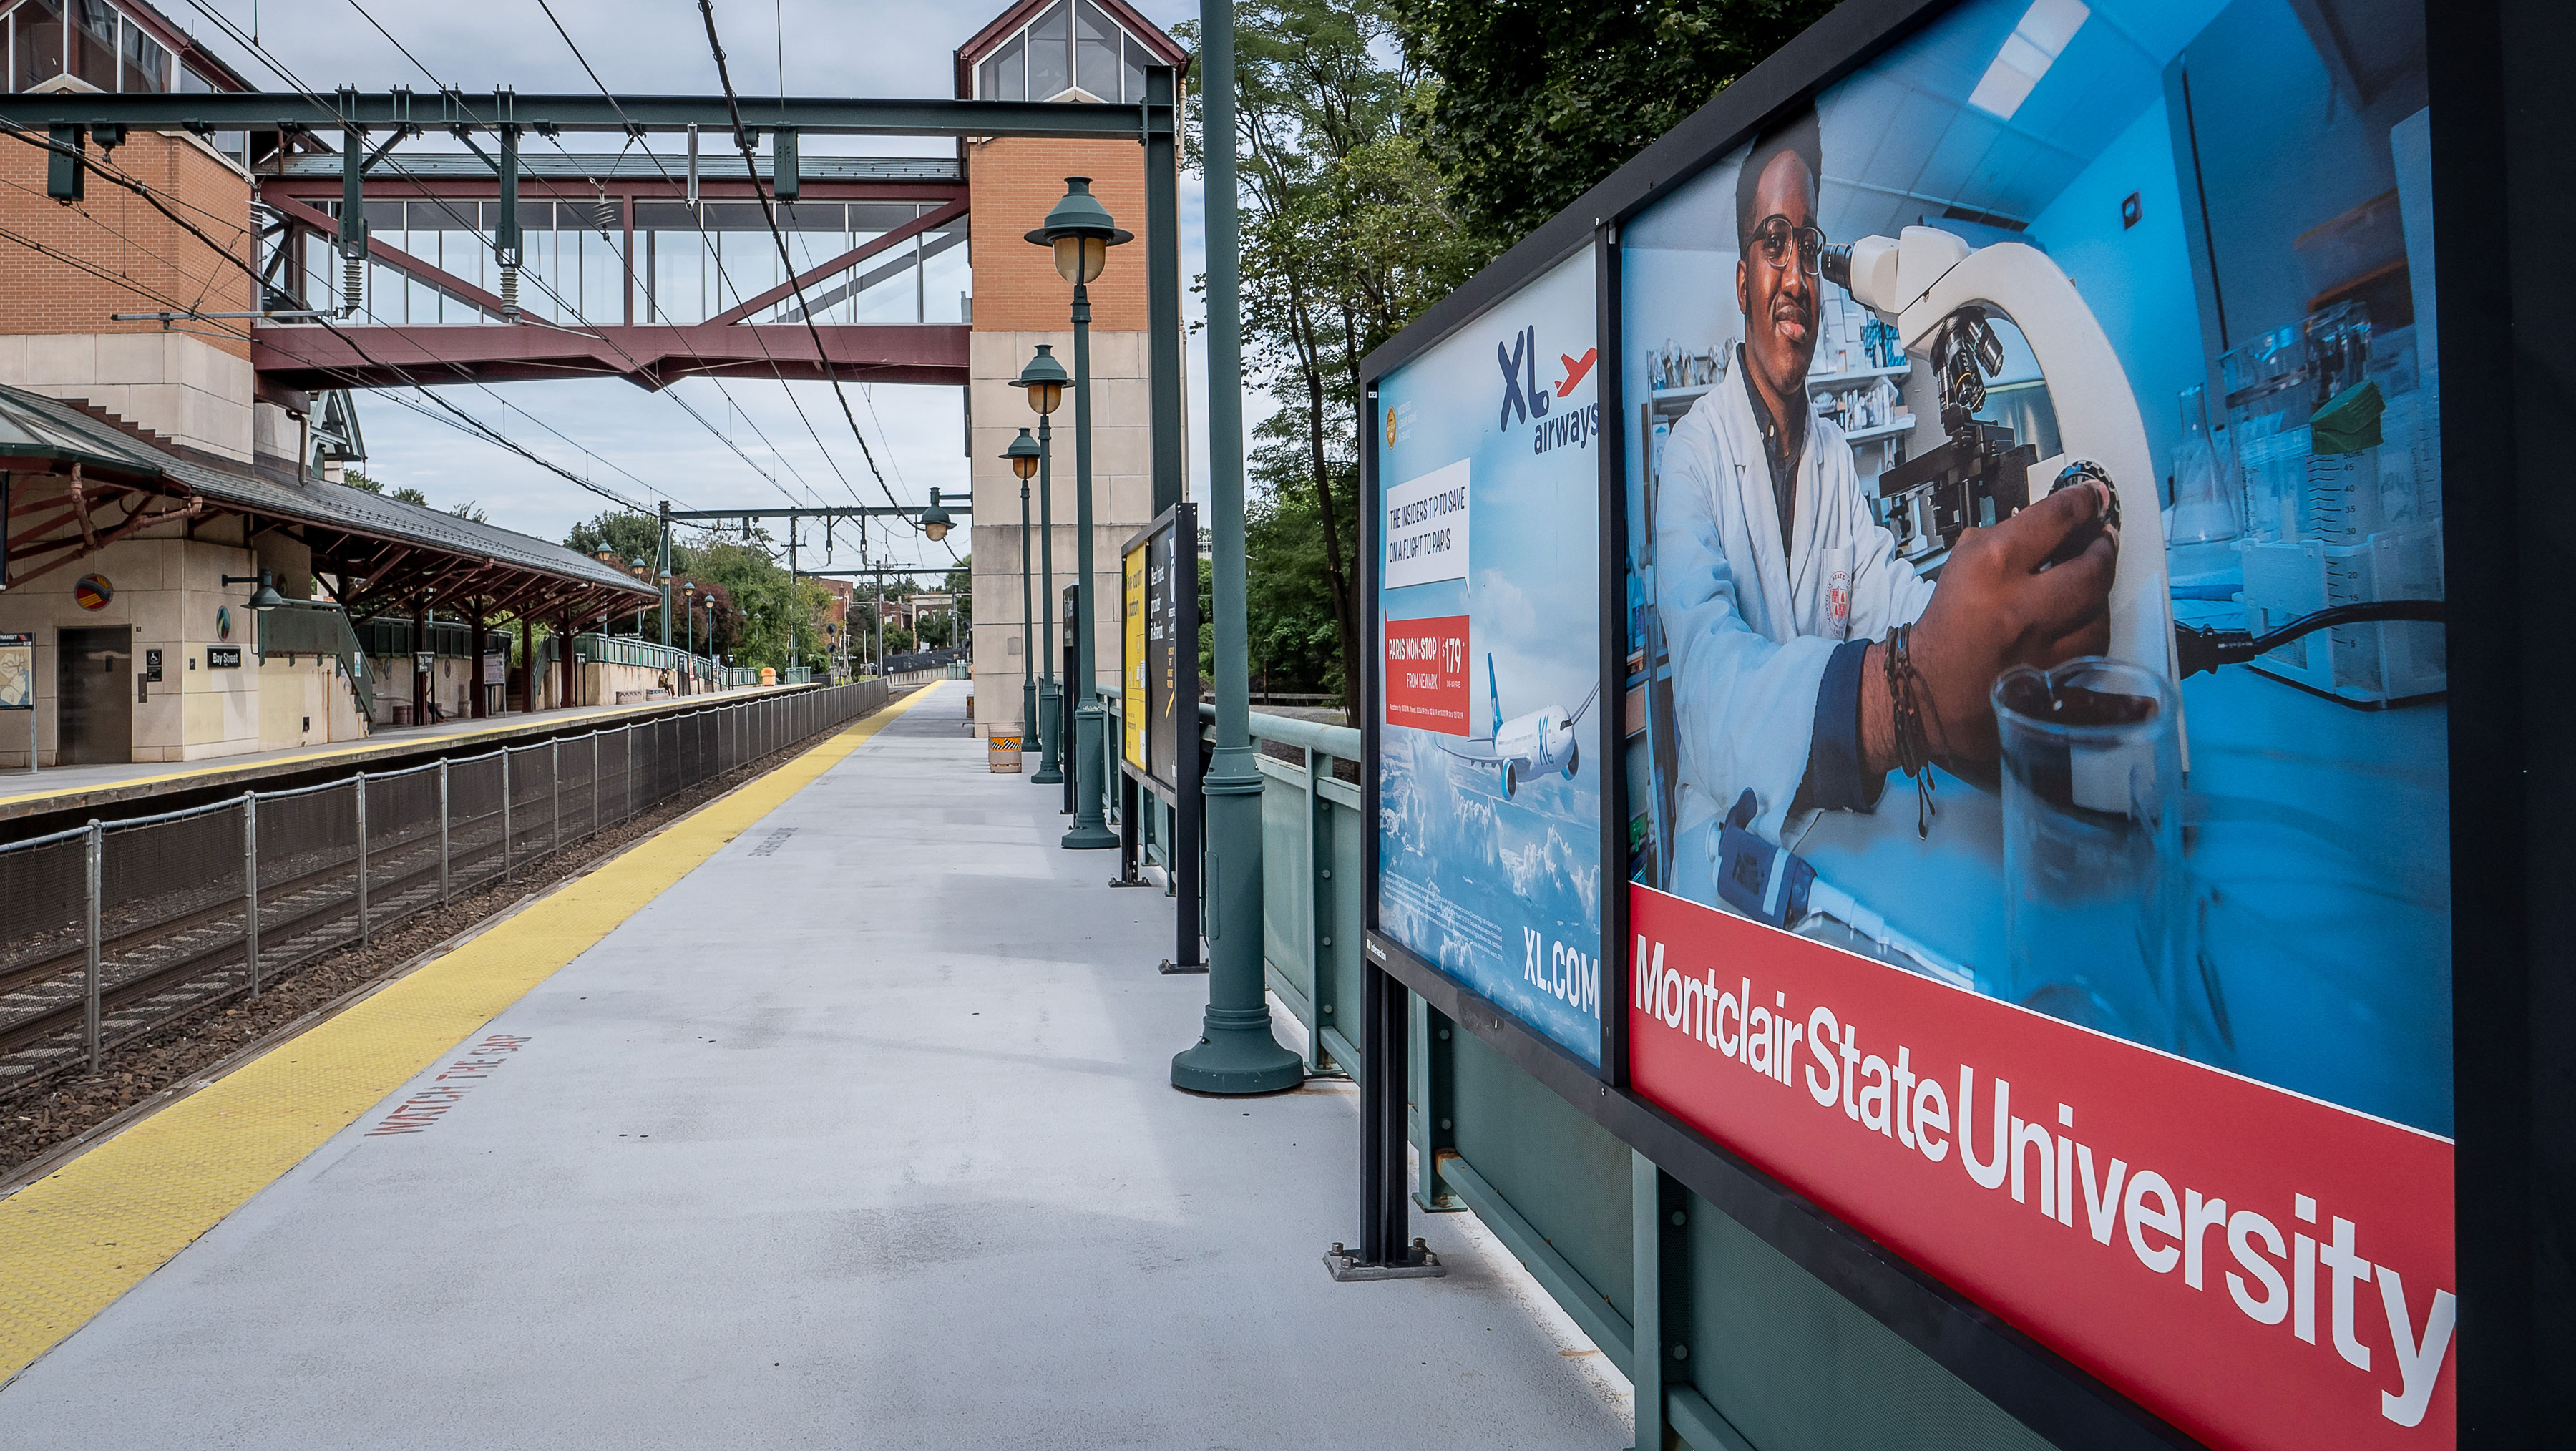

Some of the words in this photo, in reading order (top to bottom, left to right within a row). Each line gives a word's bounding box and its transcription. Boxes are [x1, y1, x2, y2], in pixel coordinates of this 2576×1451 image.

[1498, 324, 1549, 433] XL
[1534, 403, 1598, 455] airways
[1390, 508, 1400, 530] THE
[1401, 499, 1428, 527] INSIDERS
[1428, 495, 1438, 519] TIP
[1439, 492, 1448, 516] TO
[1448, 486, 1465, 513] SAVE
[2346, 505, 2356, 514] 35
[1390, 541, 1397, 563] ON
[1397, 540, 1402, 561] A
[1403, 535, 1423, 560] FLIGHT
[1423, 532, 1431, 555] TO
[1433, 527, 1450, 554] PARIS
[213, 653, 223, 665] Bay
[223, 653, 238, 663] Street
[1389, 638, 1405, 660] PARIS
[1406, 637, 1437, 660] NON-STOP
[1407, 673, 1418, 688] FROM
[1419, 673, 1438, 690] NEWARK
[1523, 925, 1600, 1020] XL.COM
[467, 1035, 533, 1055] GAP
[435, 1058, 507, 1082] THE
[364, 1085, 476, 1137] WATCH
[1636, 934, 1803, 1088] Montclair
[1805, 1006, 1951, 1163] State
[1958, 1063, 2456, 1427] University
